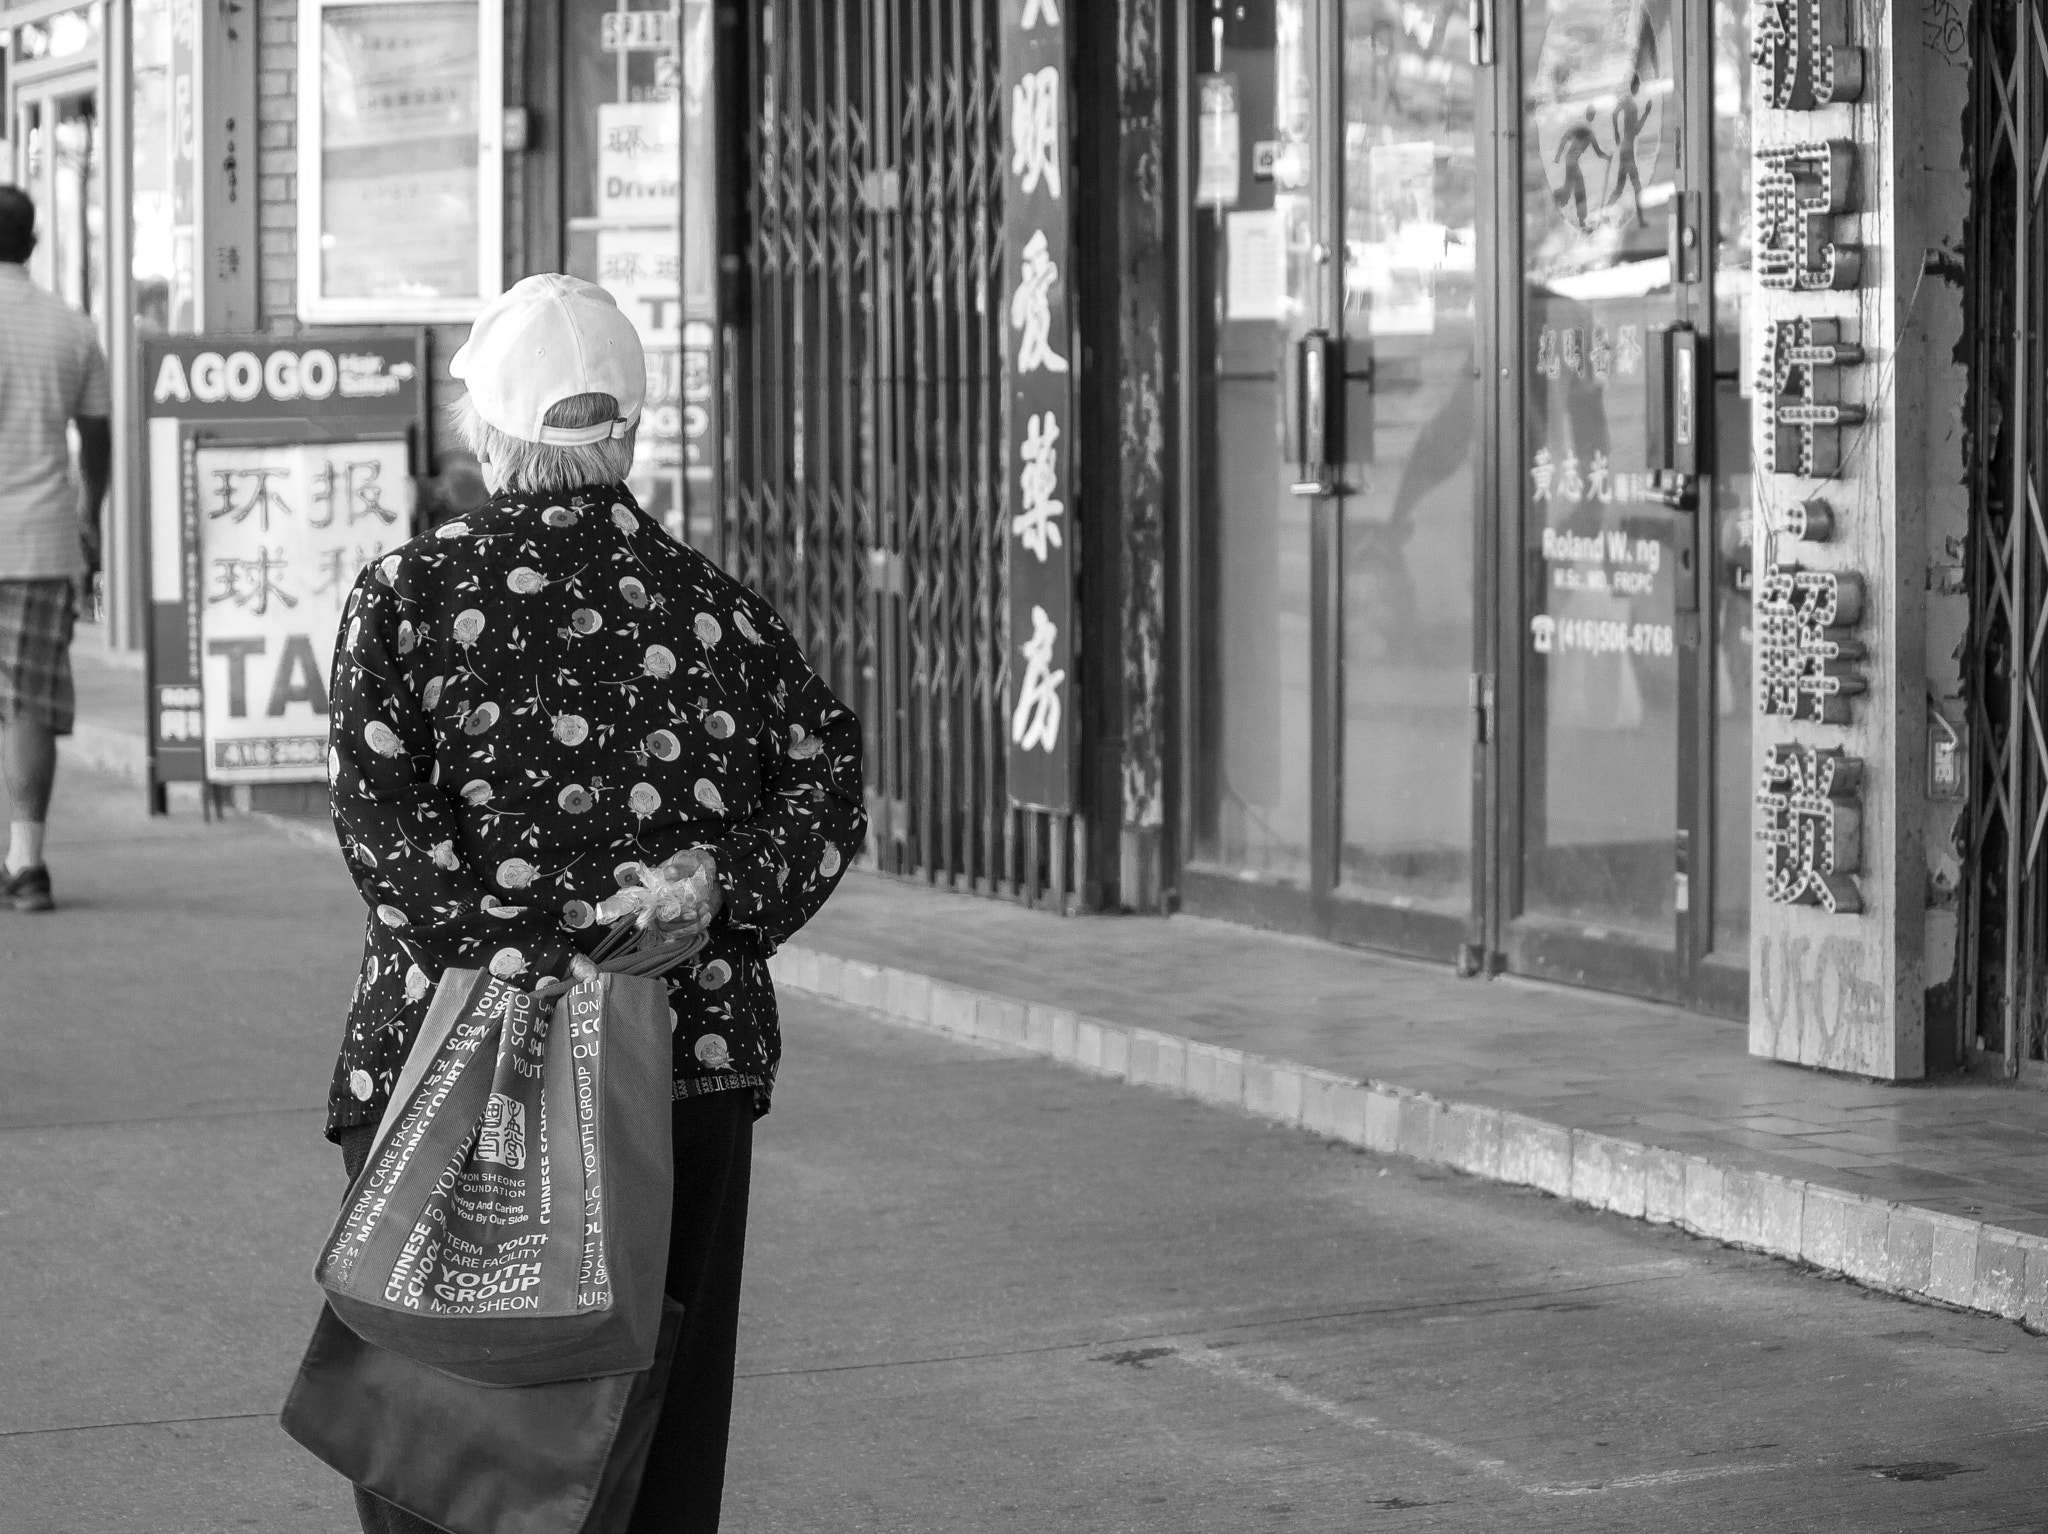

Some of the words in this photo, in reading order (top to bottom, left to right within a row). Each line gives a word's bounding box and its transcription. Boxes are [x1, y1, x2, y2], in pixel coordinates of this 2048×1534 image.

[1543, 527, 1604, 562] Roland
[578, 1066, 594, 1121] GROUP
[345, 1190, 375, 1232] TERM
[370, 1149, 399, 1192] CARE
[391, 1088, 432, 1147] FACILITY
[583, 1124, 598, 1179] YOUTH
[481, 1173, 526, 1188] SHEONG
[457, 1208, 474, 1222] You
[476, 1214, 487, 1225] By
[489, 1214, 507, 1225] Our
[508, 1214, 529, 1225] Side
[476, 1200, 493, 1211] And
[495, 1202, 524, 1214] Caring
[447, 1231, 483, 1255] TERM
[385, 1223, 432, 1302] CHINESE
[443, 1248, 480, 1270] CARE
[483, 1248, 541, 1269] FACILITY
[404, 1239, 441, 1310] SCHOOL
[441, 1262, 542, 1287] YOUTH
[434, 1276, 541, 1302] GROUP
[430, 1298, 474, 1315] MON
[477, 1296, 539, 1314] SHEON
